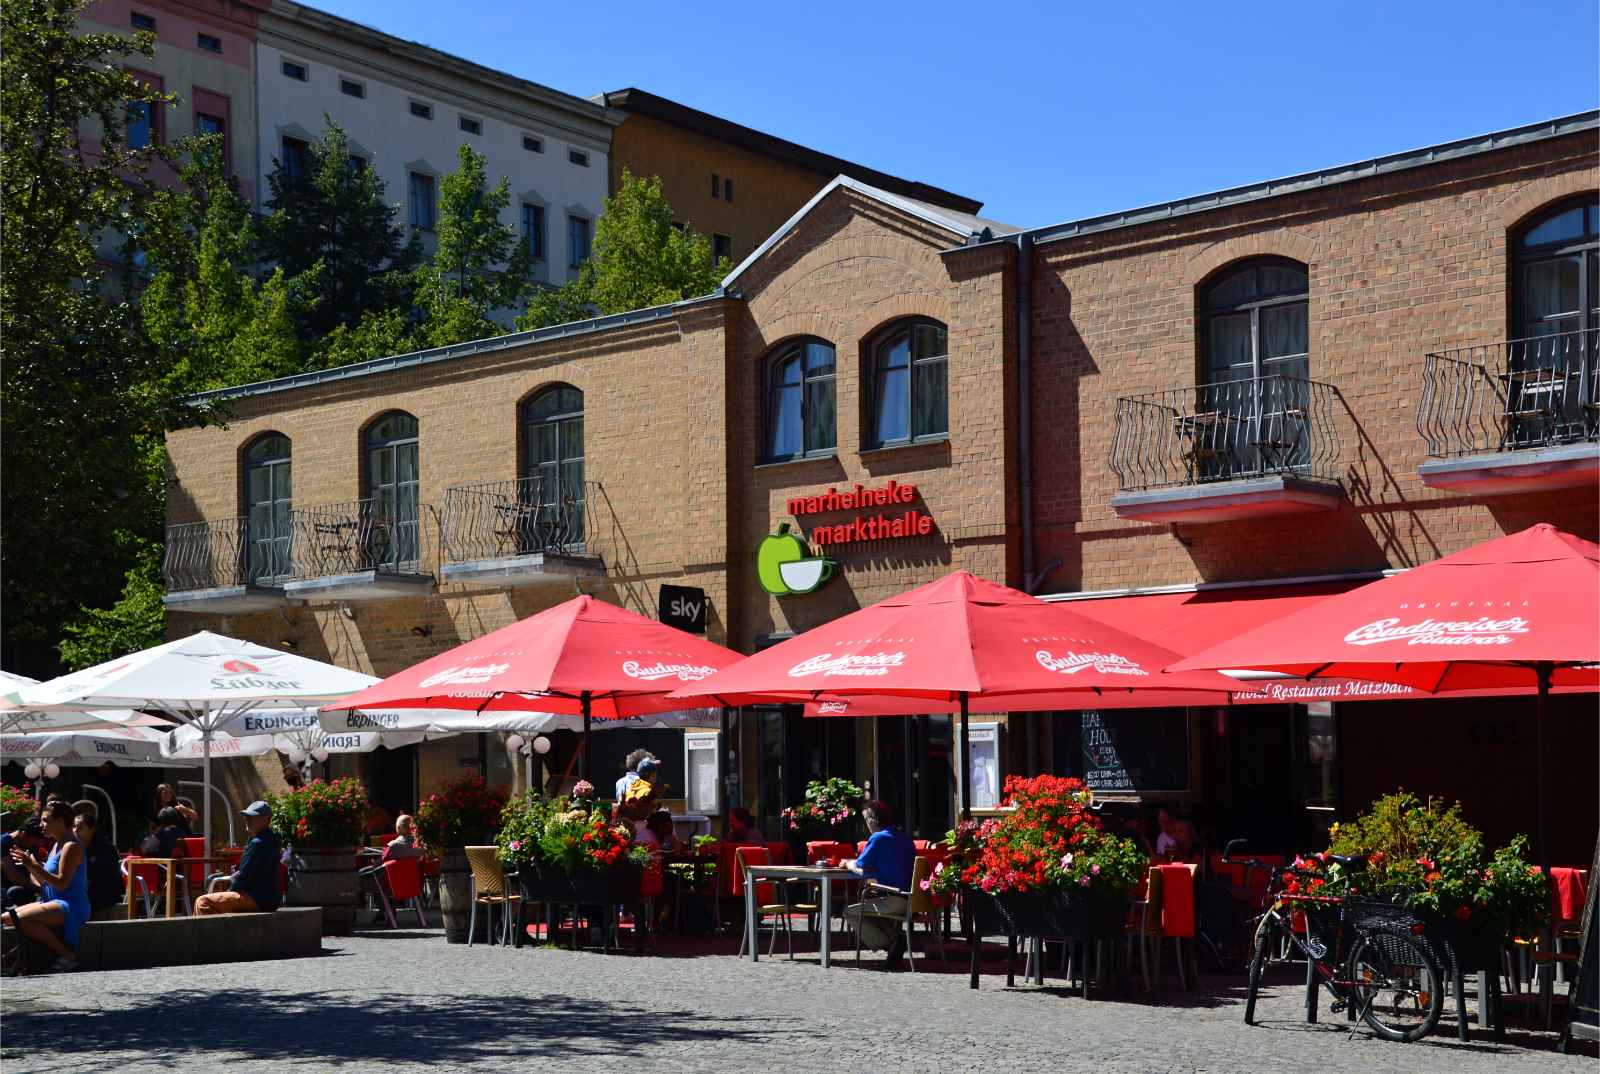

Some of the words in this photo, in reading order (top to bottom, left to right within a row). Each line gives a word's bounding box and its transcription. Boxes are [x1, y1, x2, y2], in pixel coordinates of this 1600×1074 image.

[786, 480, 917, 516] marheineke
[813, 511, 934, 545] markthalle
[670, 596, 701, 622] sky
[1344, 616, 1530, 646] Budweiser
[1272, 683, 1341, 700] Restaurant
[245, 714, 319, 731] ERDINGER
[346, 709, 400, 729] ERDINGER
